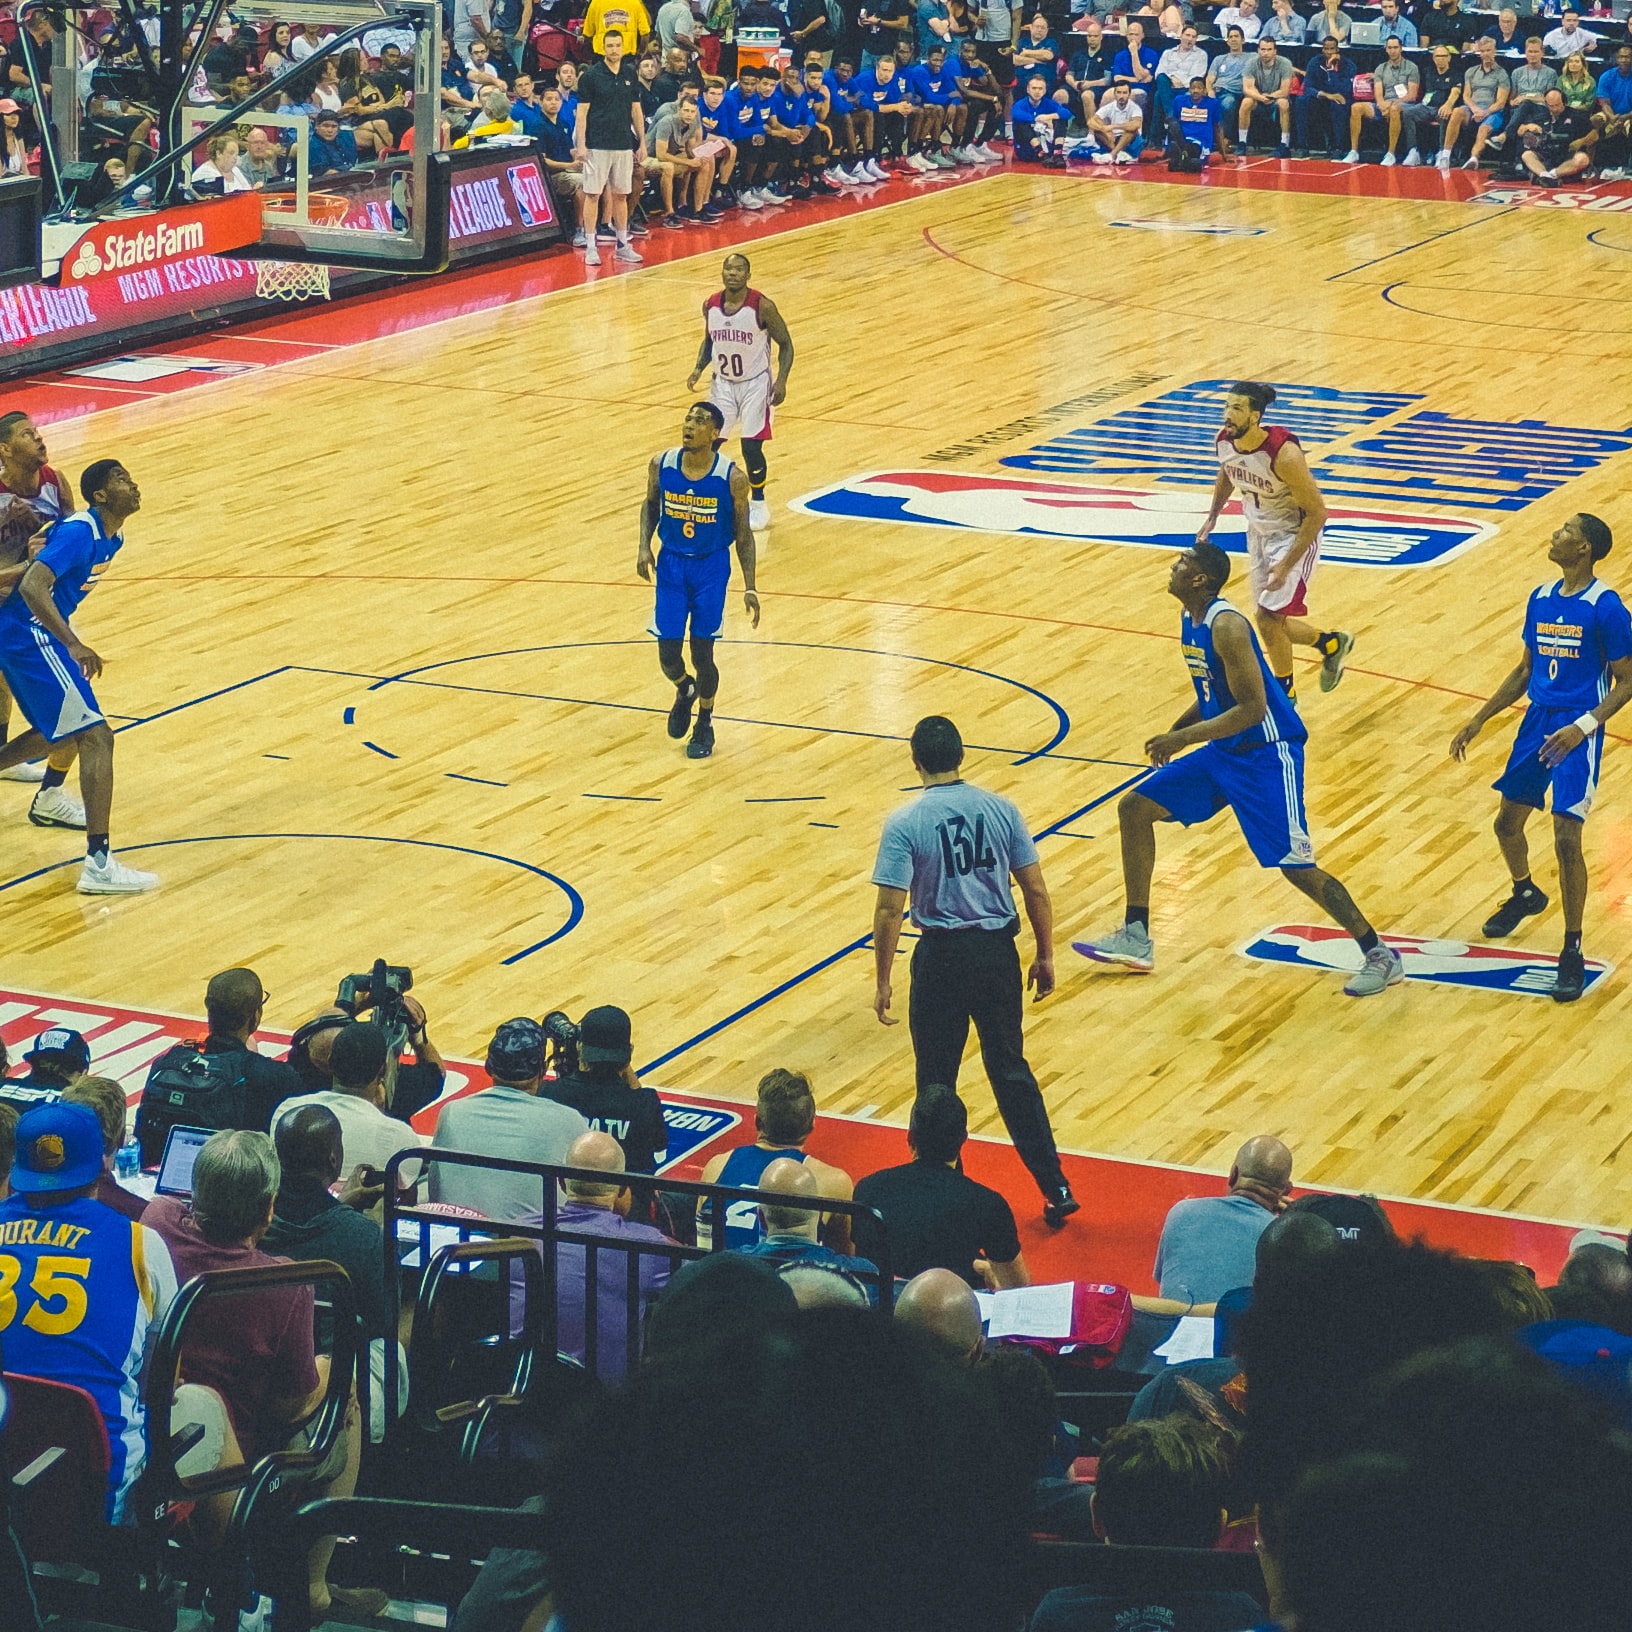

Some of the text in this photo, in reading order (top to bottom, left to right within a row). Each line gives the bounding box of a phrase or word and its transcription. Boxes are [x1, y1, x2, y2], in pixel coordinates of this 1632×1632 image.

[455, 175, 545, 236] LEAGUE TV
[20, 284, 97, 338] LEAGUE
[120, 270, 164, 305] MGM
[167, 254, 244, 296] RESORTS
[719, 353, 744, 378] 20
[664, 489, 718, 507] WARRIORS
[682, 521, 695, 539] 6
[1323, 525, 1430, 563] NBA
[1536, 622, 1583, 639] WARRIORS
[1548, 658, 1559, 681] 0
[1202, 680, 1211, 702] 5
[935, 813, 998, 879] 134
[1511, 966, 1560, 995] NBA
